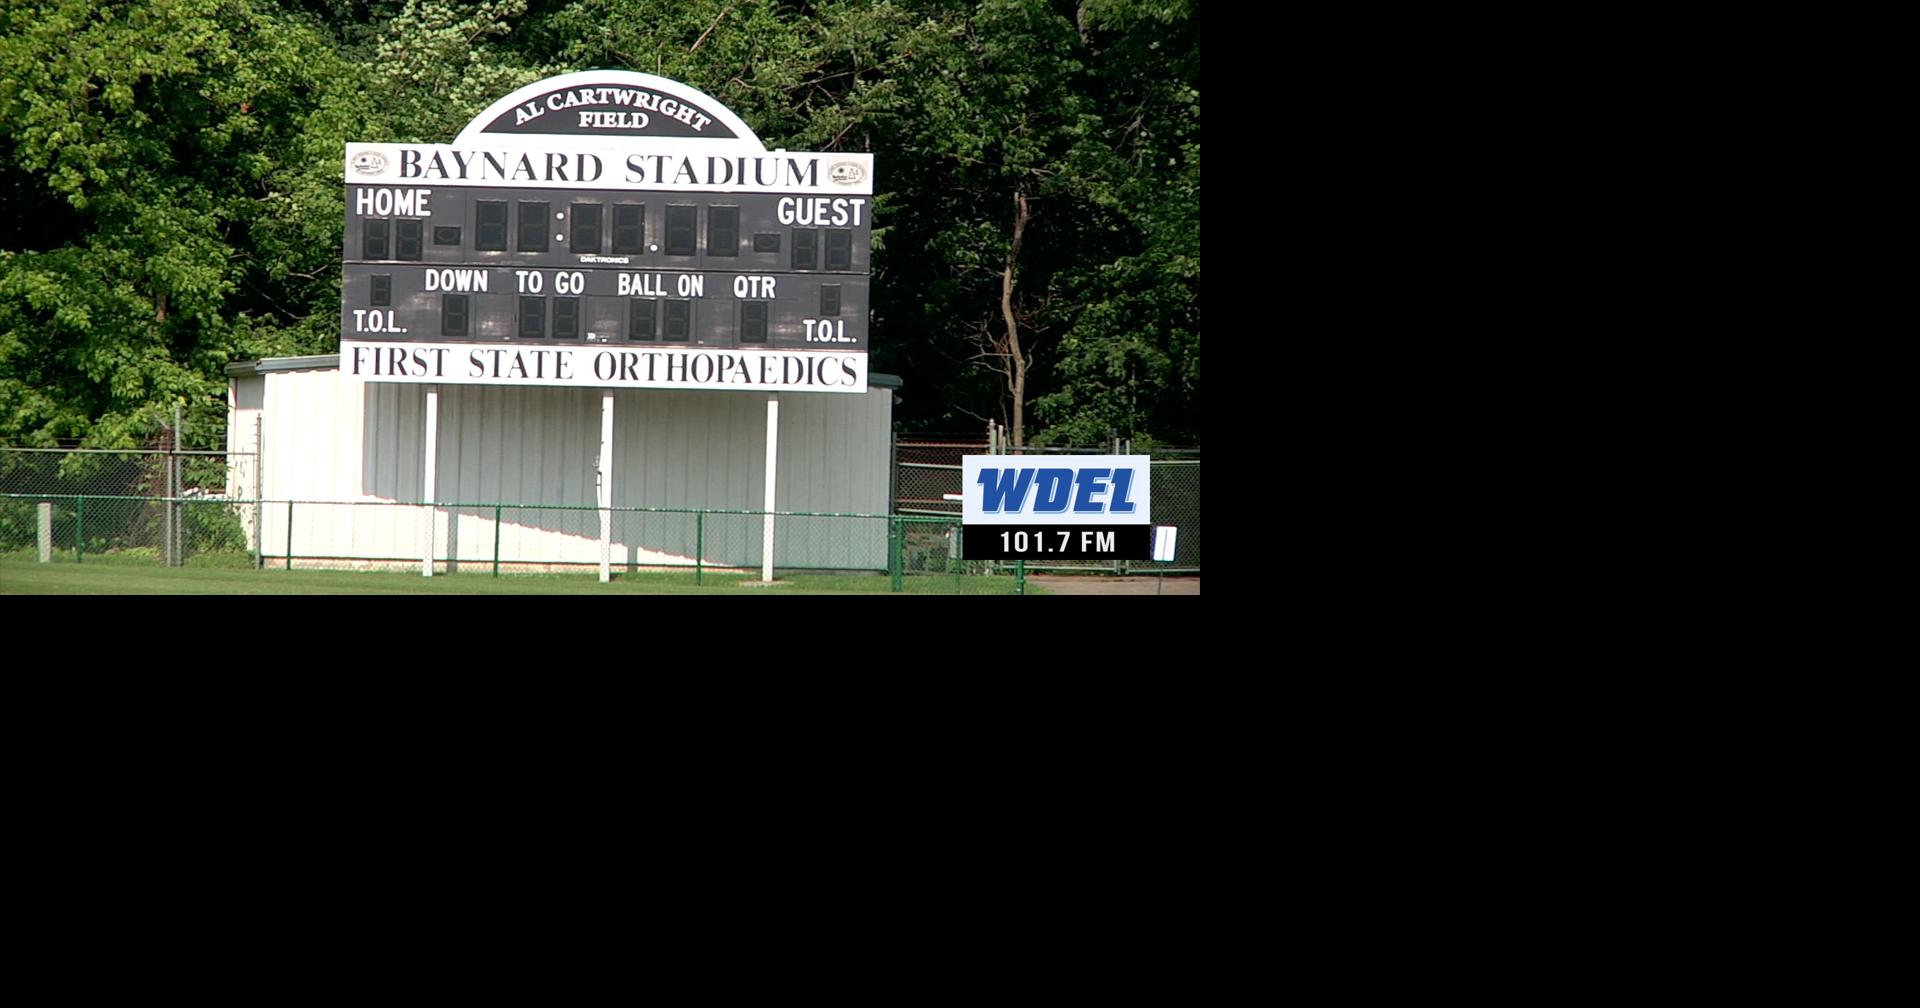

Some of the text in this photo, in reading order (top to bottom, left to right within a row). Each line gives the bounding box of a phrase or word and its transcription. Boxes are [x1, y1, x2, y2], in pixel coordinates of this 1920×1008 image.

[515, 88, 711, 131] AL CARTWRIGHT
[578, 111, 649, 128] FIELD
[399, 149, 602, 182] BAYNARD
[626, 153, 819, 187] STADIUM
[356, 187, 431, 216] HOME
[778, 197, 865, 226] GUEST
[425, 269, 488, 292] DOWN
[516, 271, 584, 295] TO GO
[618, 273, 704, 297] BALL ON
[734, 276, 776, 299] QTR
[353, 310, 407, 333] T.O.L.
[803, 319, 857, 343] T.O.L.
[352, 346, 858, 386] FIRST STATE ORTHOPAEDICS
